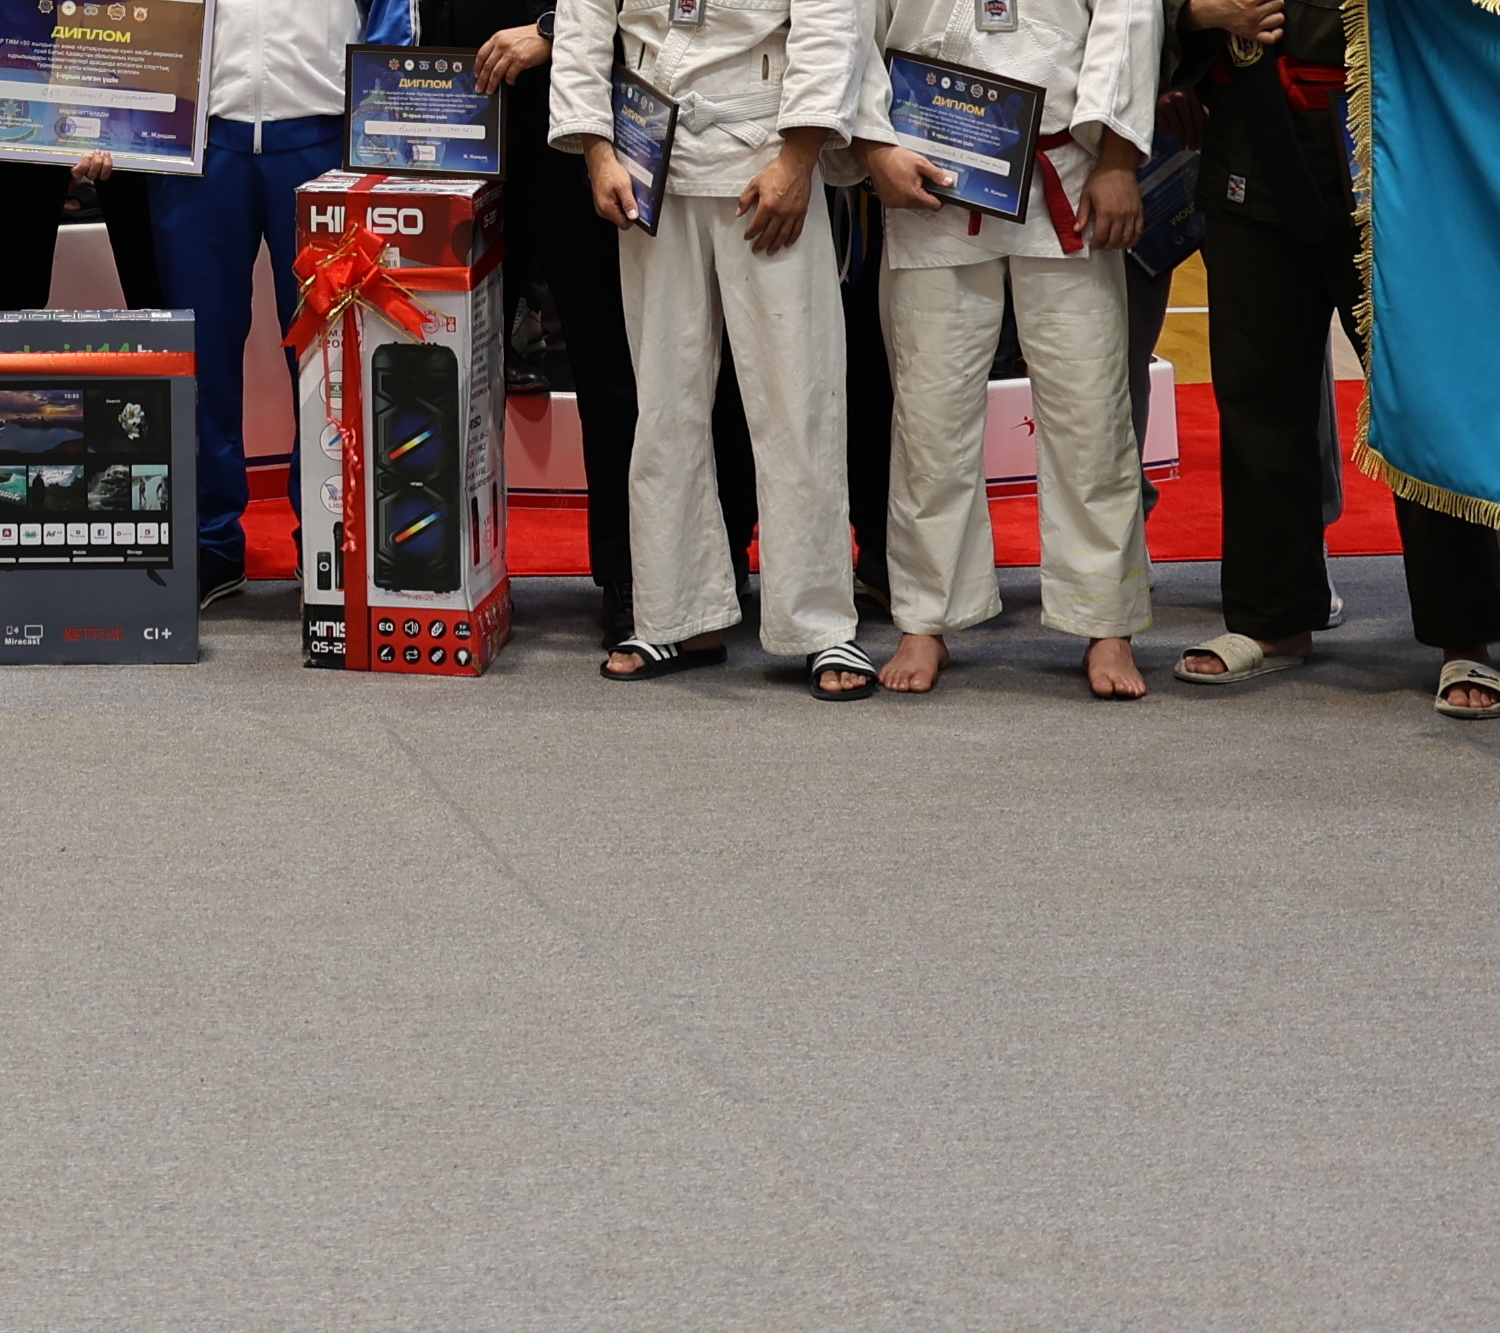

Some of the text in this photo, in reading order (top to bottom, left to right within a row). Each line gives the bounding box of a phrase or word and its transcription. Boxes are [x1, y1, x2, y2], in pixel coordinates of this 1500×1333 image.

[51, 25, 131, 44] ДИПЛОМ
[398, 78, 453, 90] ДИПЛОМ
[931, 95, 986, 118] ДИПЛОМ
[310, 205, 424, 235] KIISO
[143, 627, 173, 641] CI+
[308, 620, 347, 638] KINIS
[378, 622, 394, 632] EQ
[4, 637, 41, 646] Miracast
[311, 640, 346, 654] QS-2
